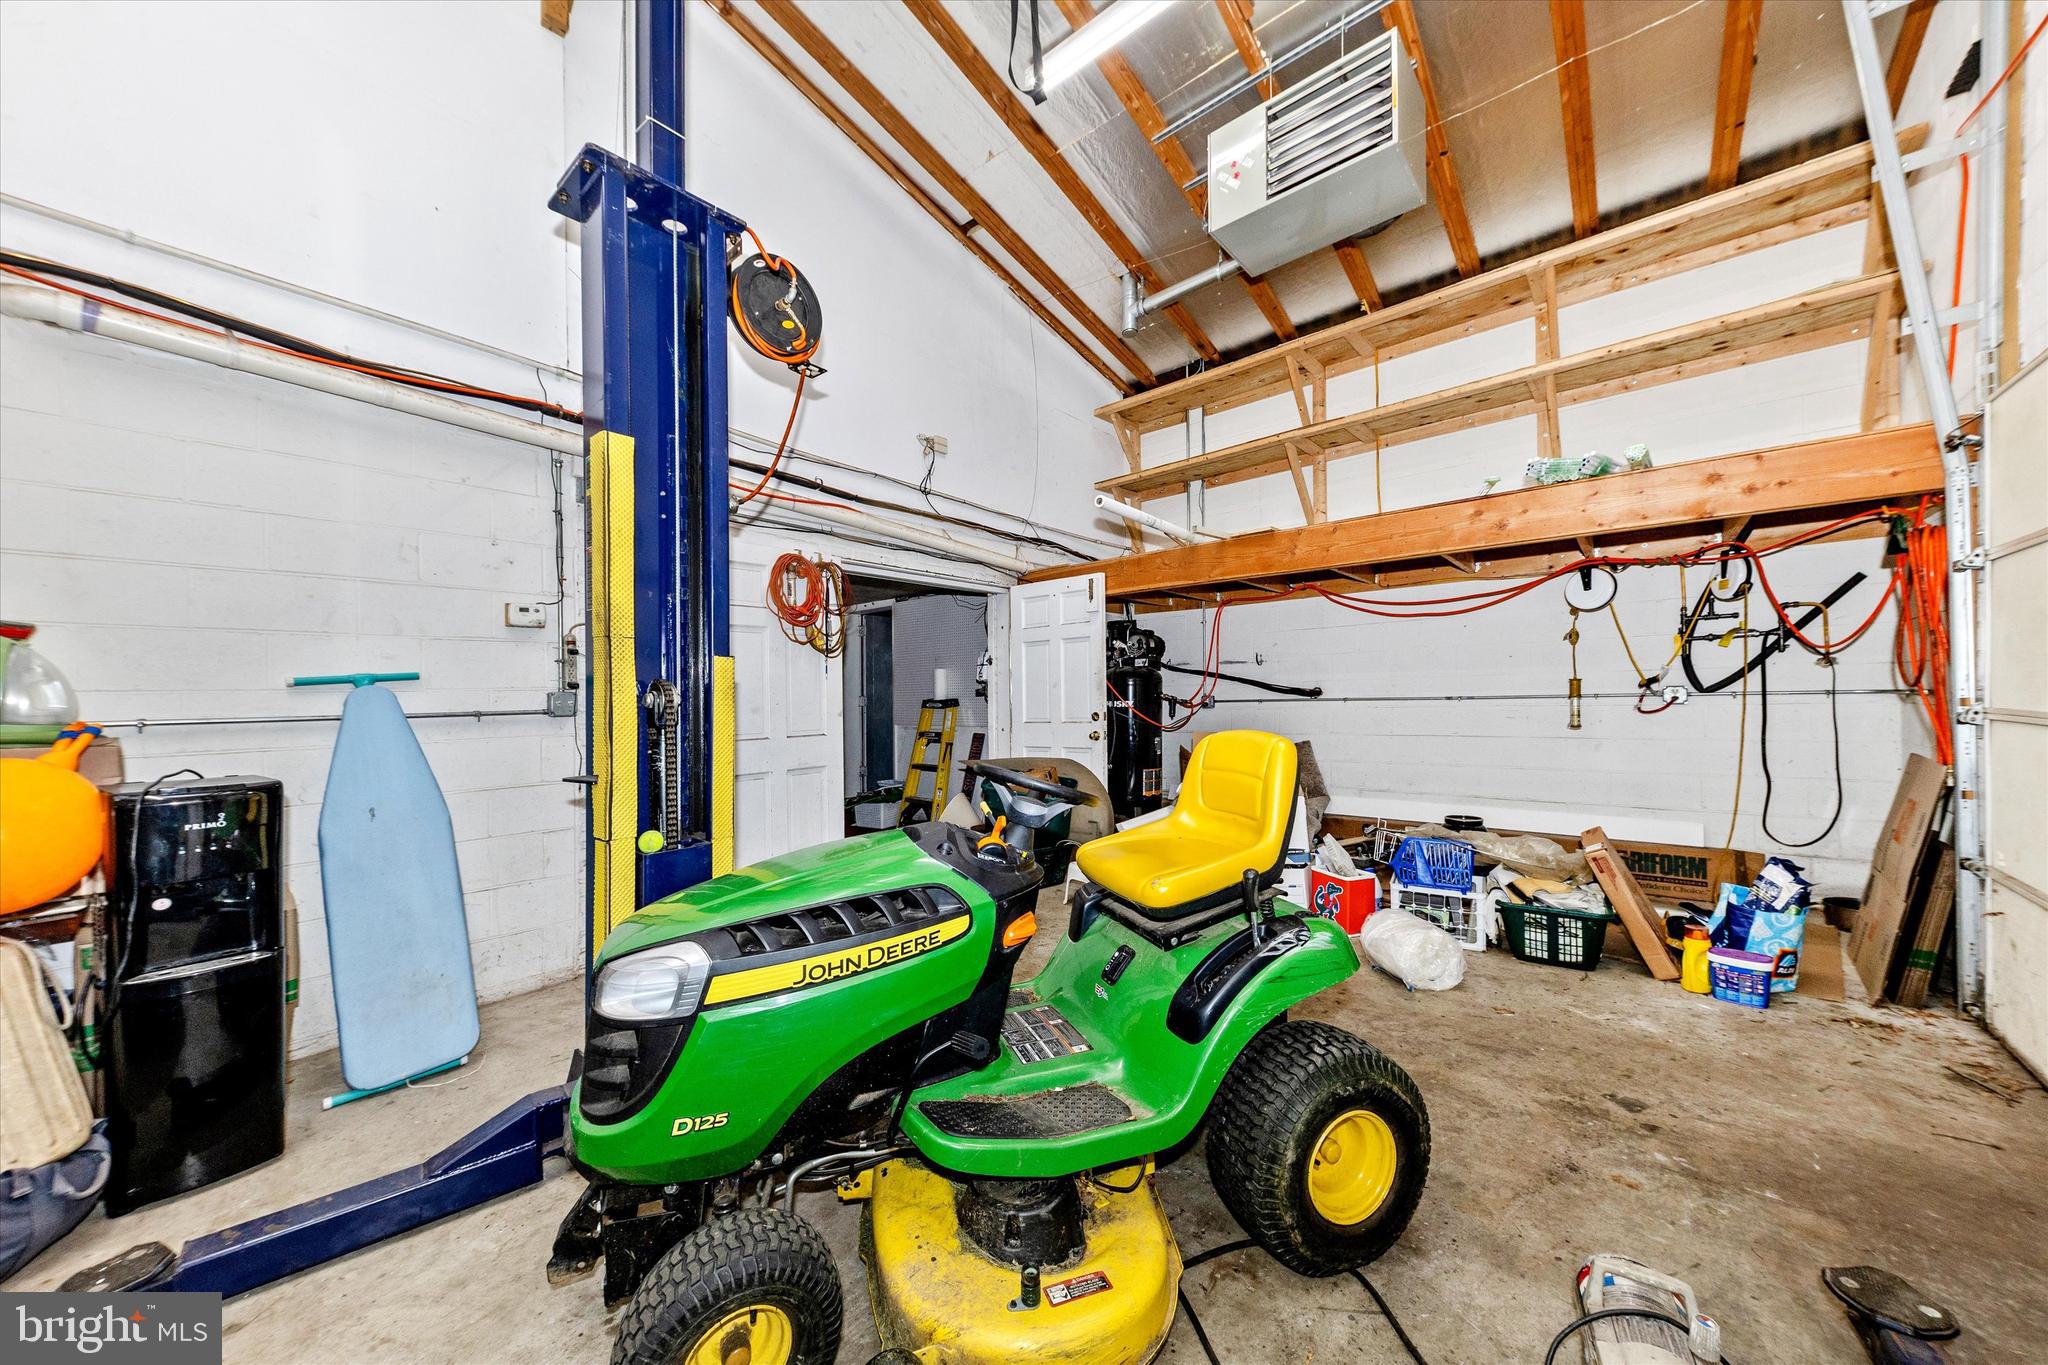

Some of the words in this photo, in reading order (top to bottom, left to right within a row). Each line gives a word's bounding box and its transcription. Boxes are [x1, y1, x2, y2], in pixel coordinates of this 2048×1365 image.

[184, 819, 227, 831] PRIMO
[792, 954, 863, 986] JOHN
[867, 929, 941, 966] DEERE
[671, 1112, 729, 1137] D125
